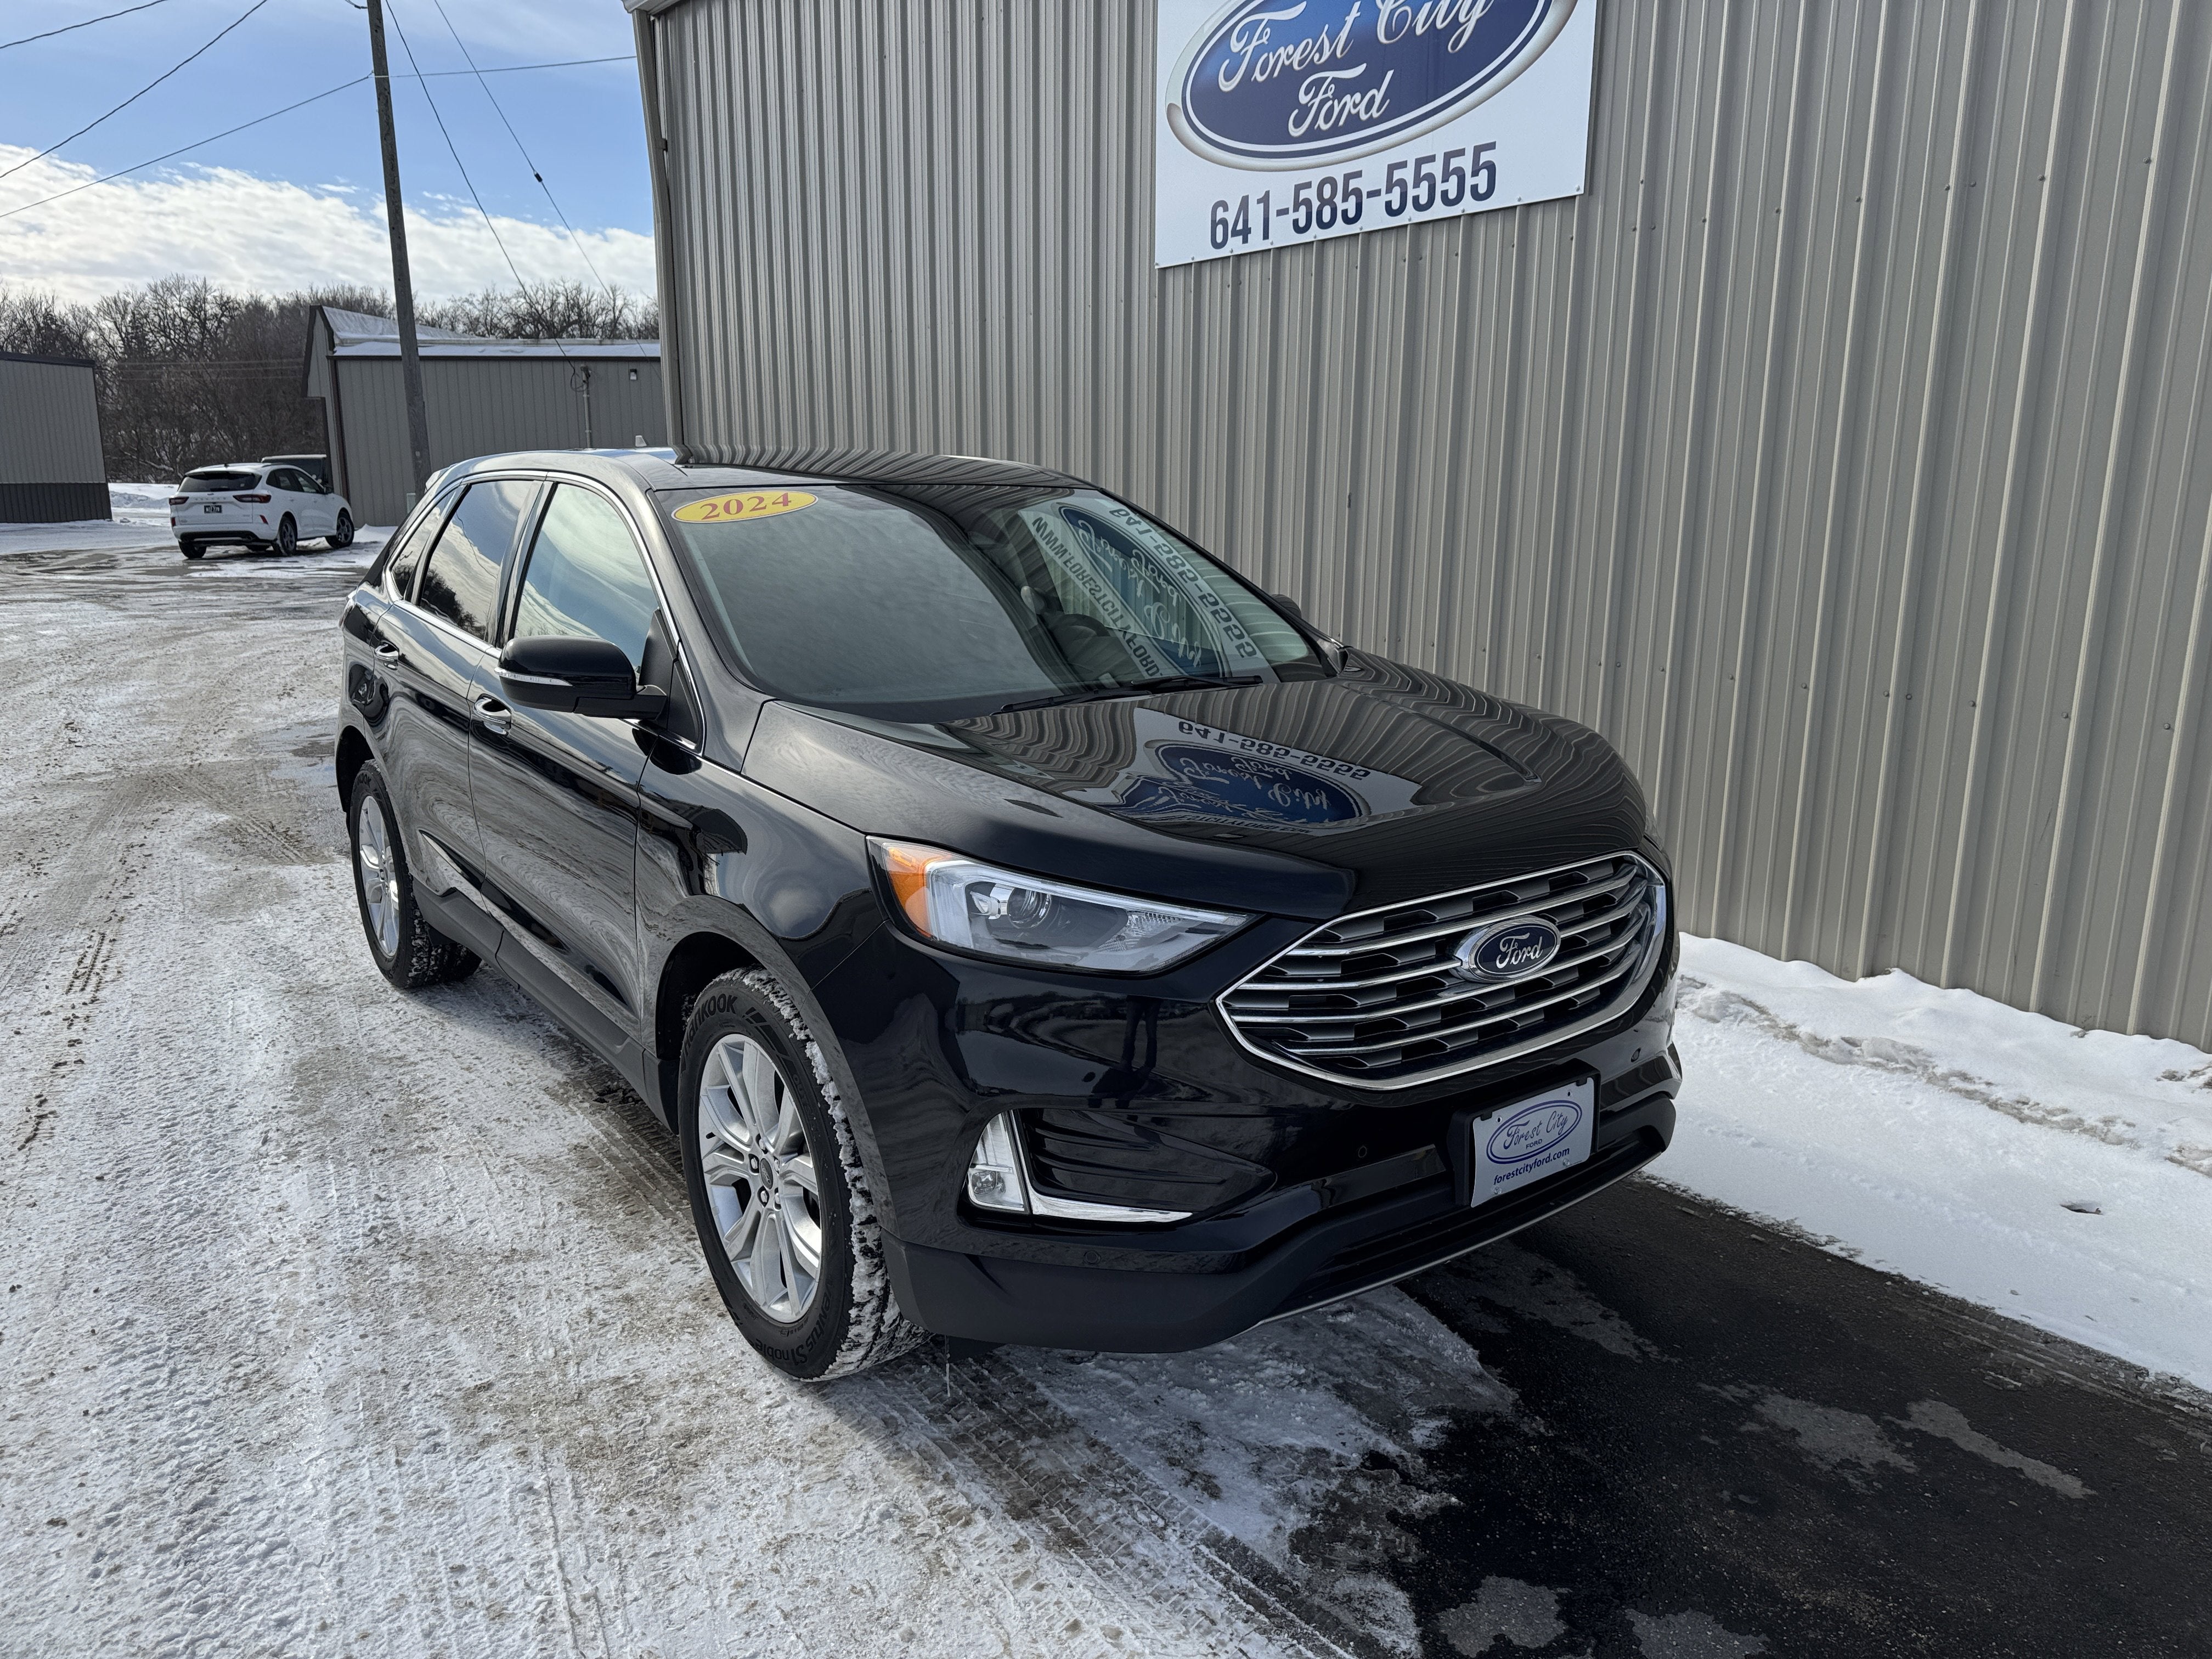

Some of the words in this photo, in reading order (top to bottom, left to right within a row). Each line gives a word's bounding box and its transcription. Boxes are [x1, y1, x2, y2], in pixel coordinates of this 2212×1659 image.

[1218, 1, 1361, 92] Forest
[1288, 63, 1394, 138] Ford
[1210, 140, 1497, 250] 641-585-5555
[700, 492, 792, 520] 2024
[1496, 932, 1543, 969] Ford
[1503, 1119, 1543, 1150] Forest
[1546, 1110, 1568, 1136] City
[1525, 1138, 1543, 1149] FORD
[1493, 1148, 1570, 1185] forestcityford.com
